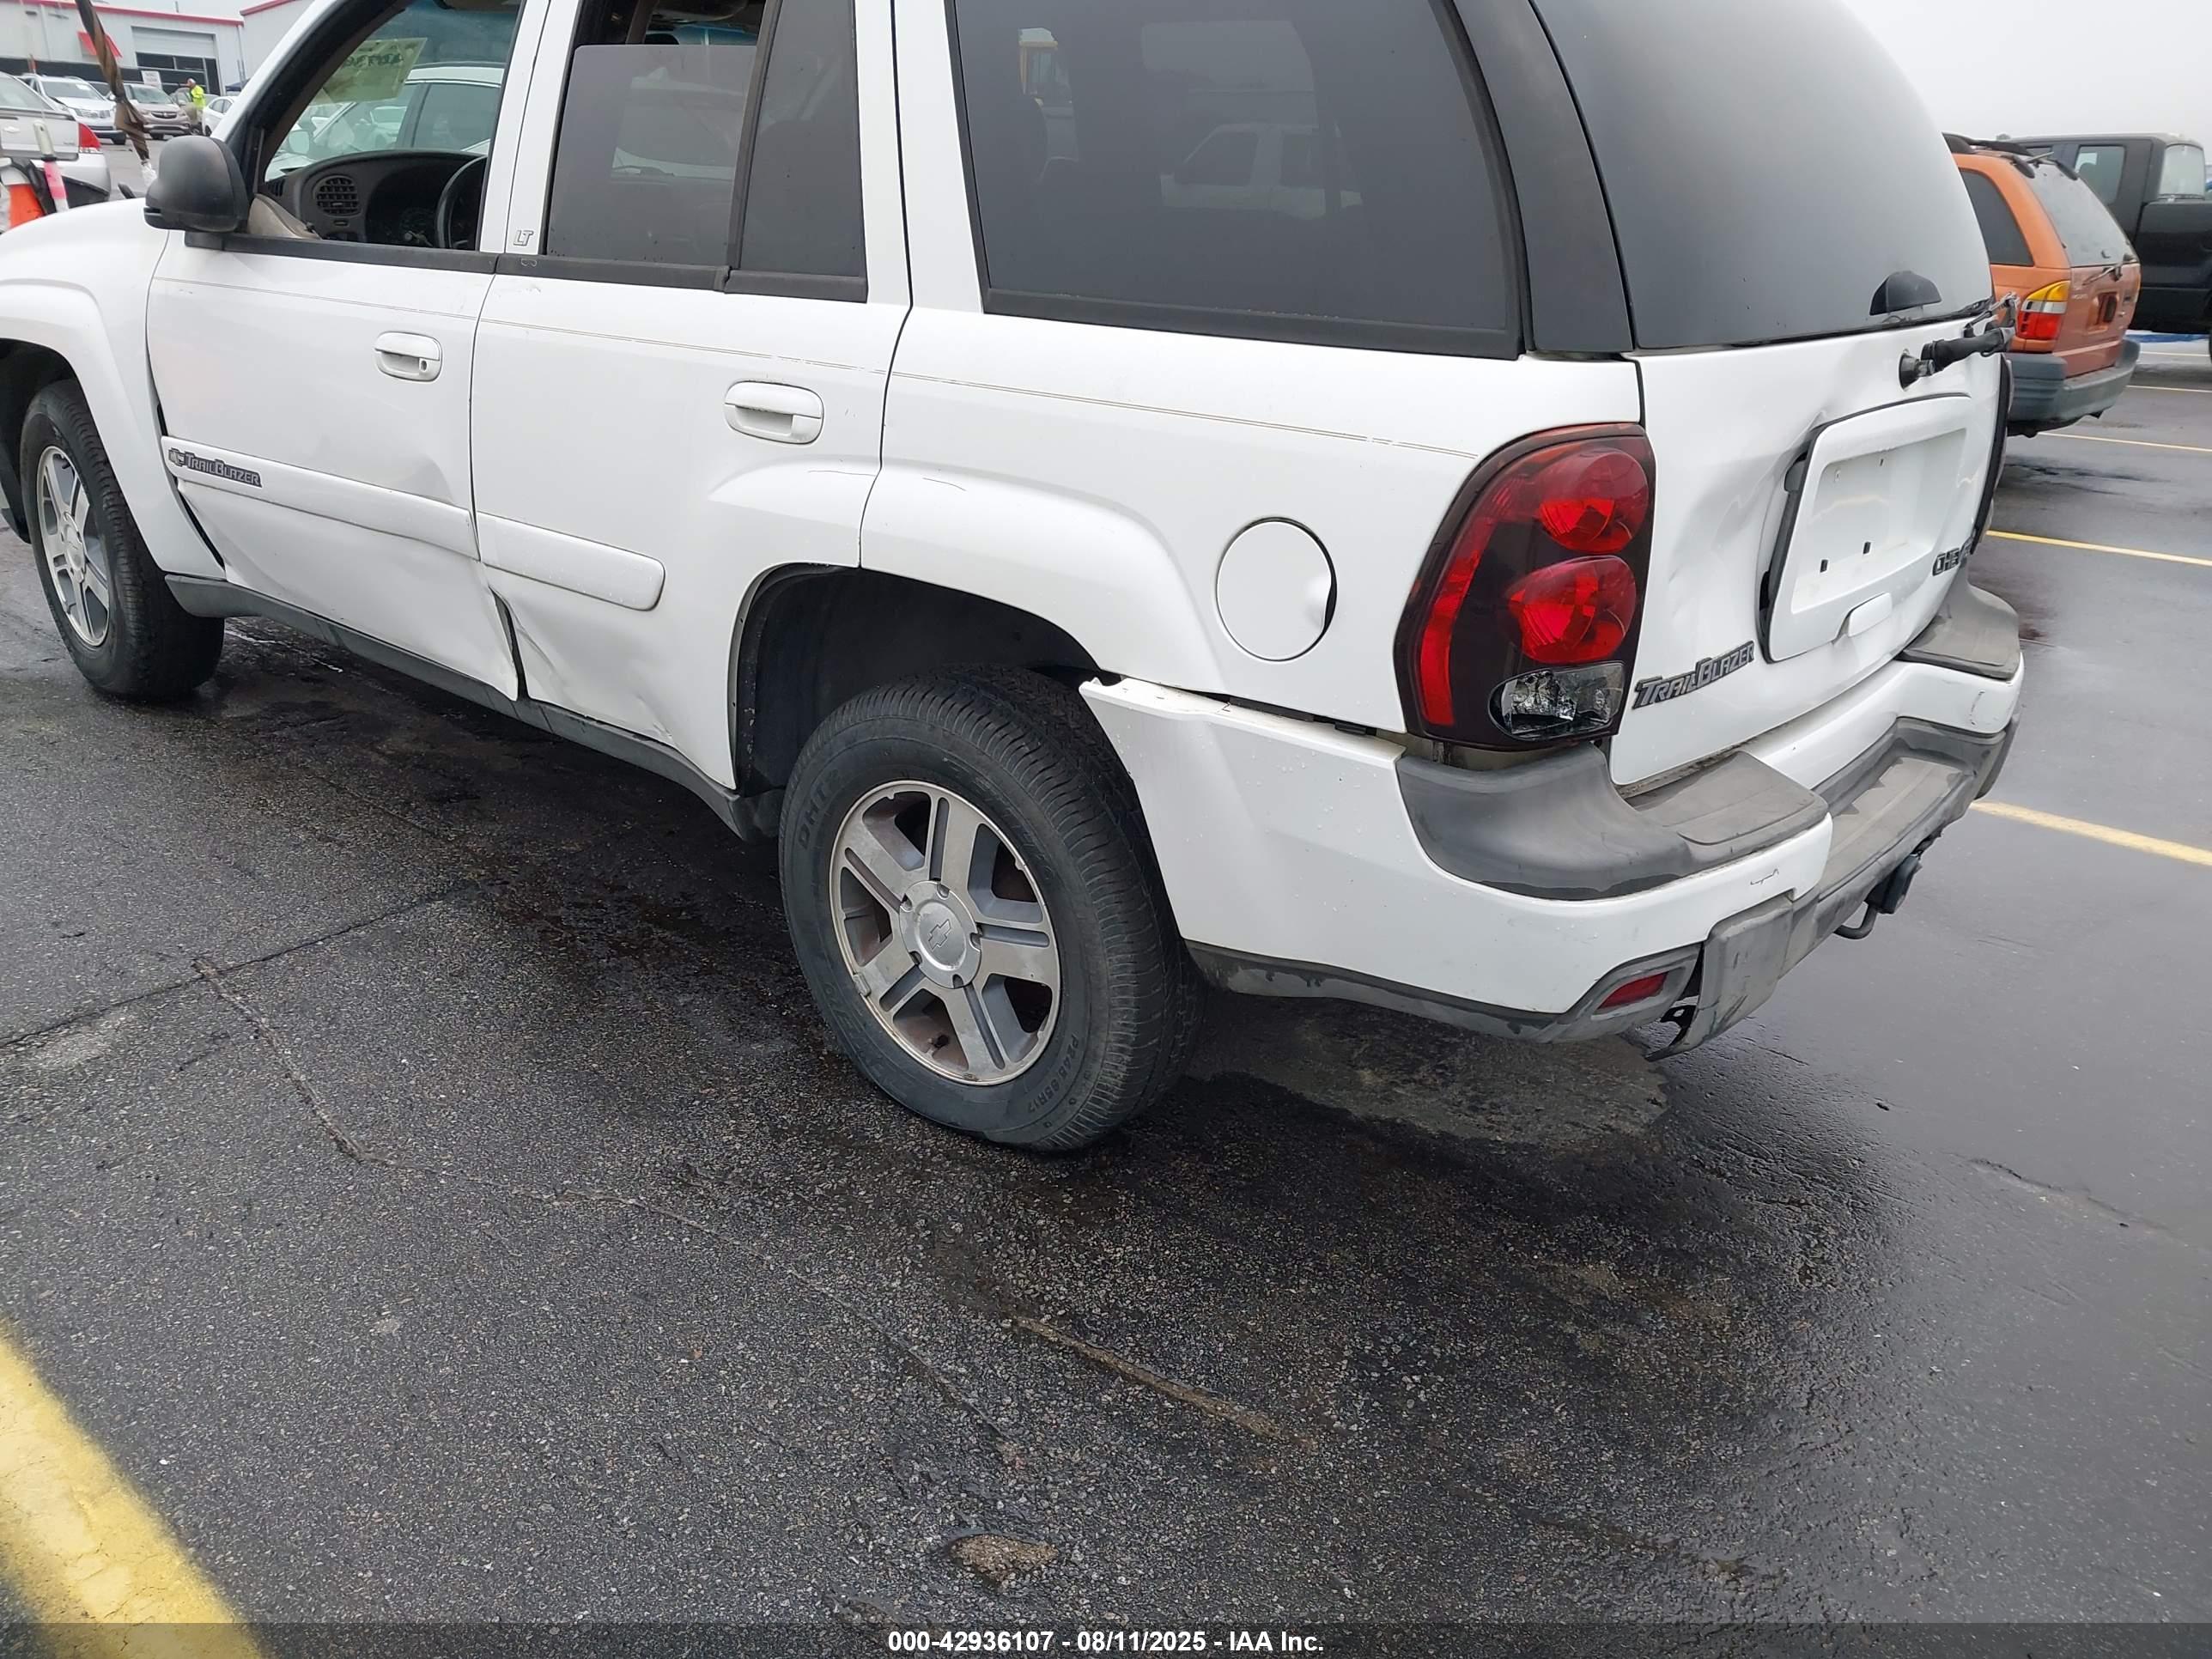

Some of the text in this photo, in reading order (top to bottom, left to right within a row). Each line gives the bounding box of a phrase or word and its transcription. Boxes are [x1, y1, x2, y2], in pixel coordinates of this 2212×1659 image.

[513, 229, 534, 246] LT
[184, 452, 261, 487] TRAILBLAZER
[1634, 642, 1754, 708] TRAILBLAZER
